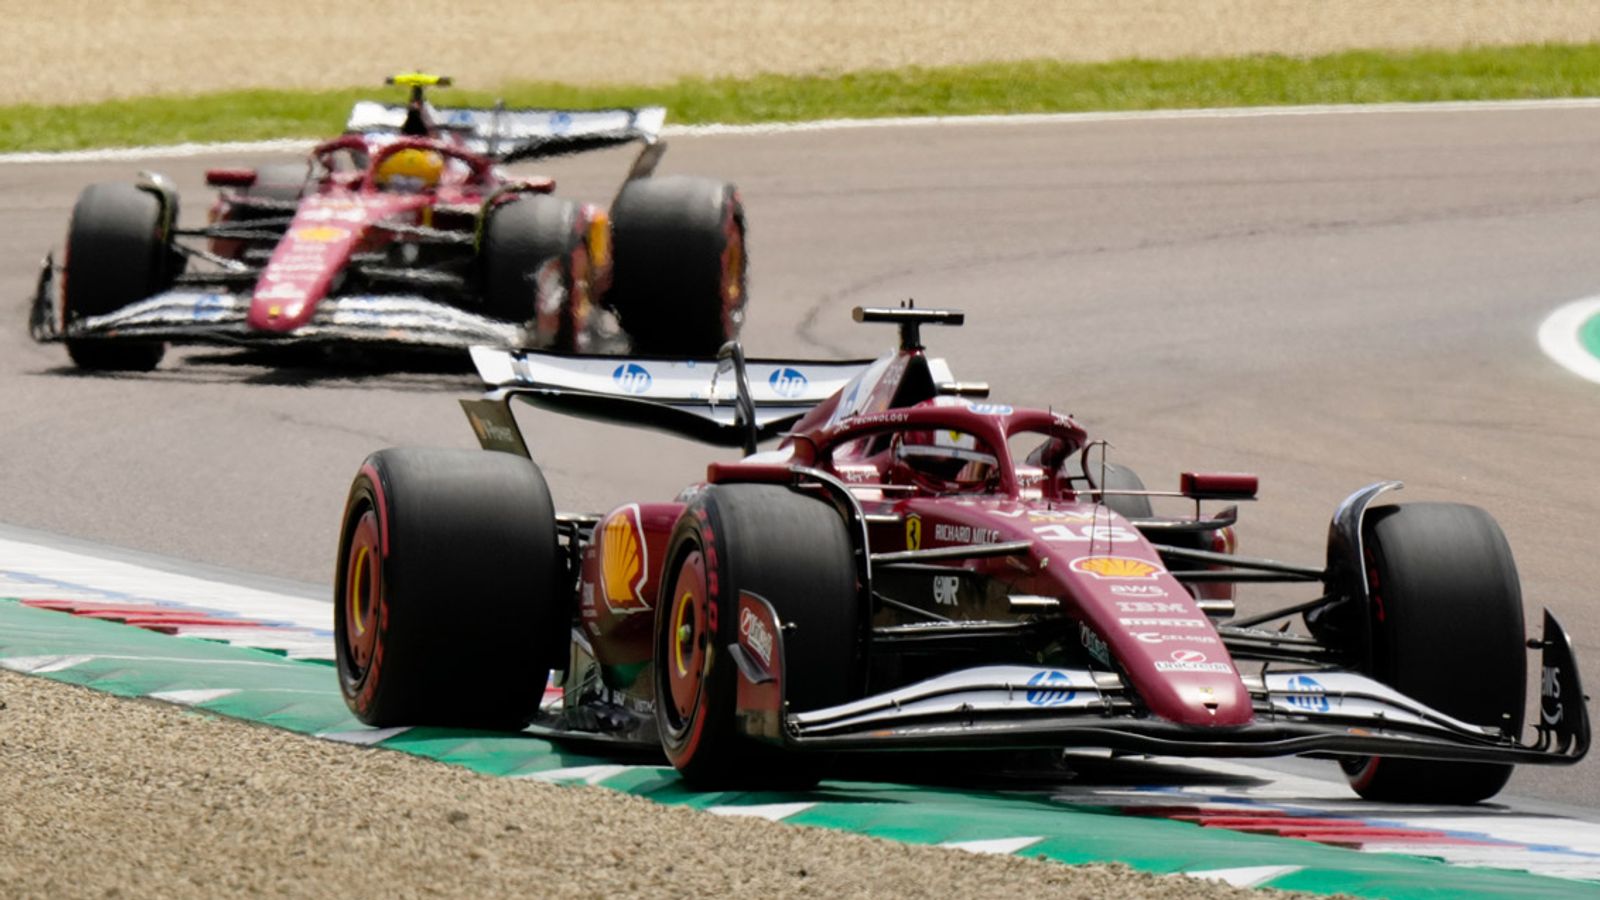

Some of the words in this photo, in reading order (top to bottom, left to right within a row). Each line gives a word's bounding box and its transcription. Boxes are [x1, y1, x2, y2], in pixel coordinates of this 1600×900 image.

[614, 363, 651, 394] hp
[770, 368, 807, 397] hp
[934, 524, 971, 543] RICHARD
[971, 527, 1000, 545] MILLE
[1032, 525, 1138, 542] 16
[1110, 585, 1166, 597] aws
[1115, 602, 1188, 613] IBM
[1026, 671, 1076, 706] hp
[1287, 676, 1329, 712] hp
